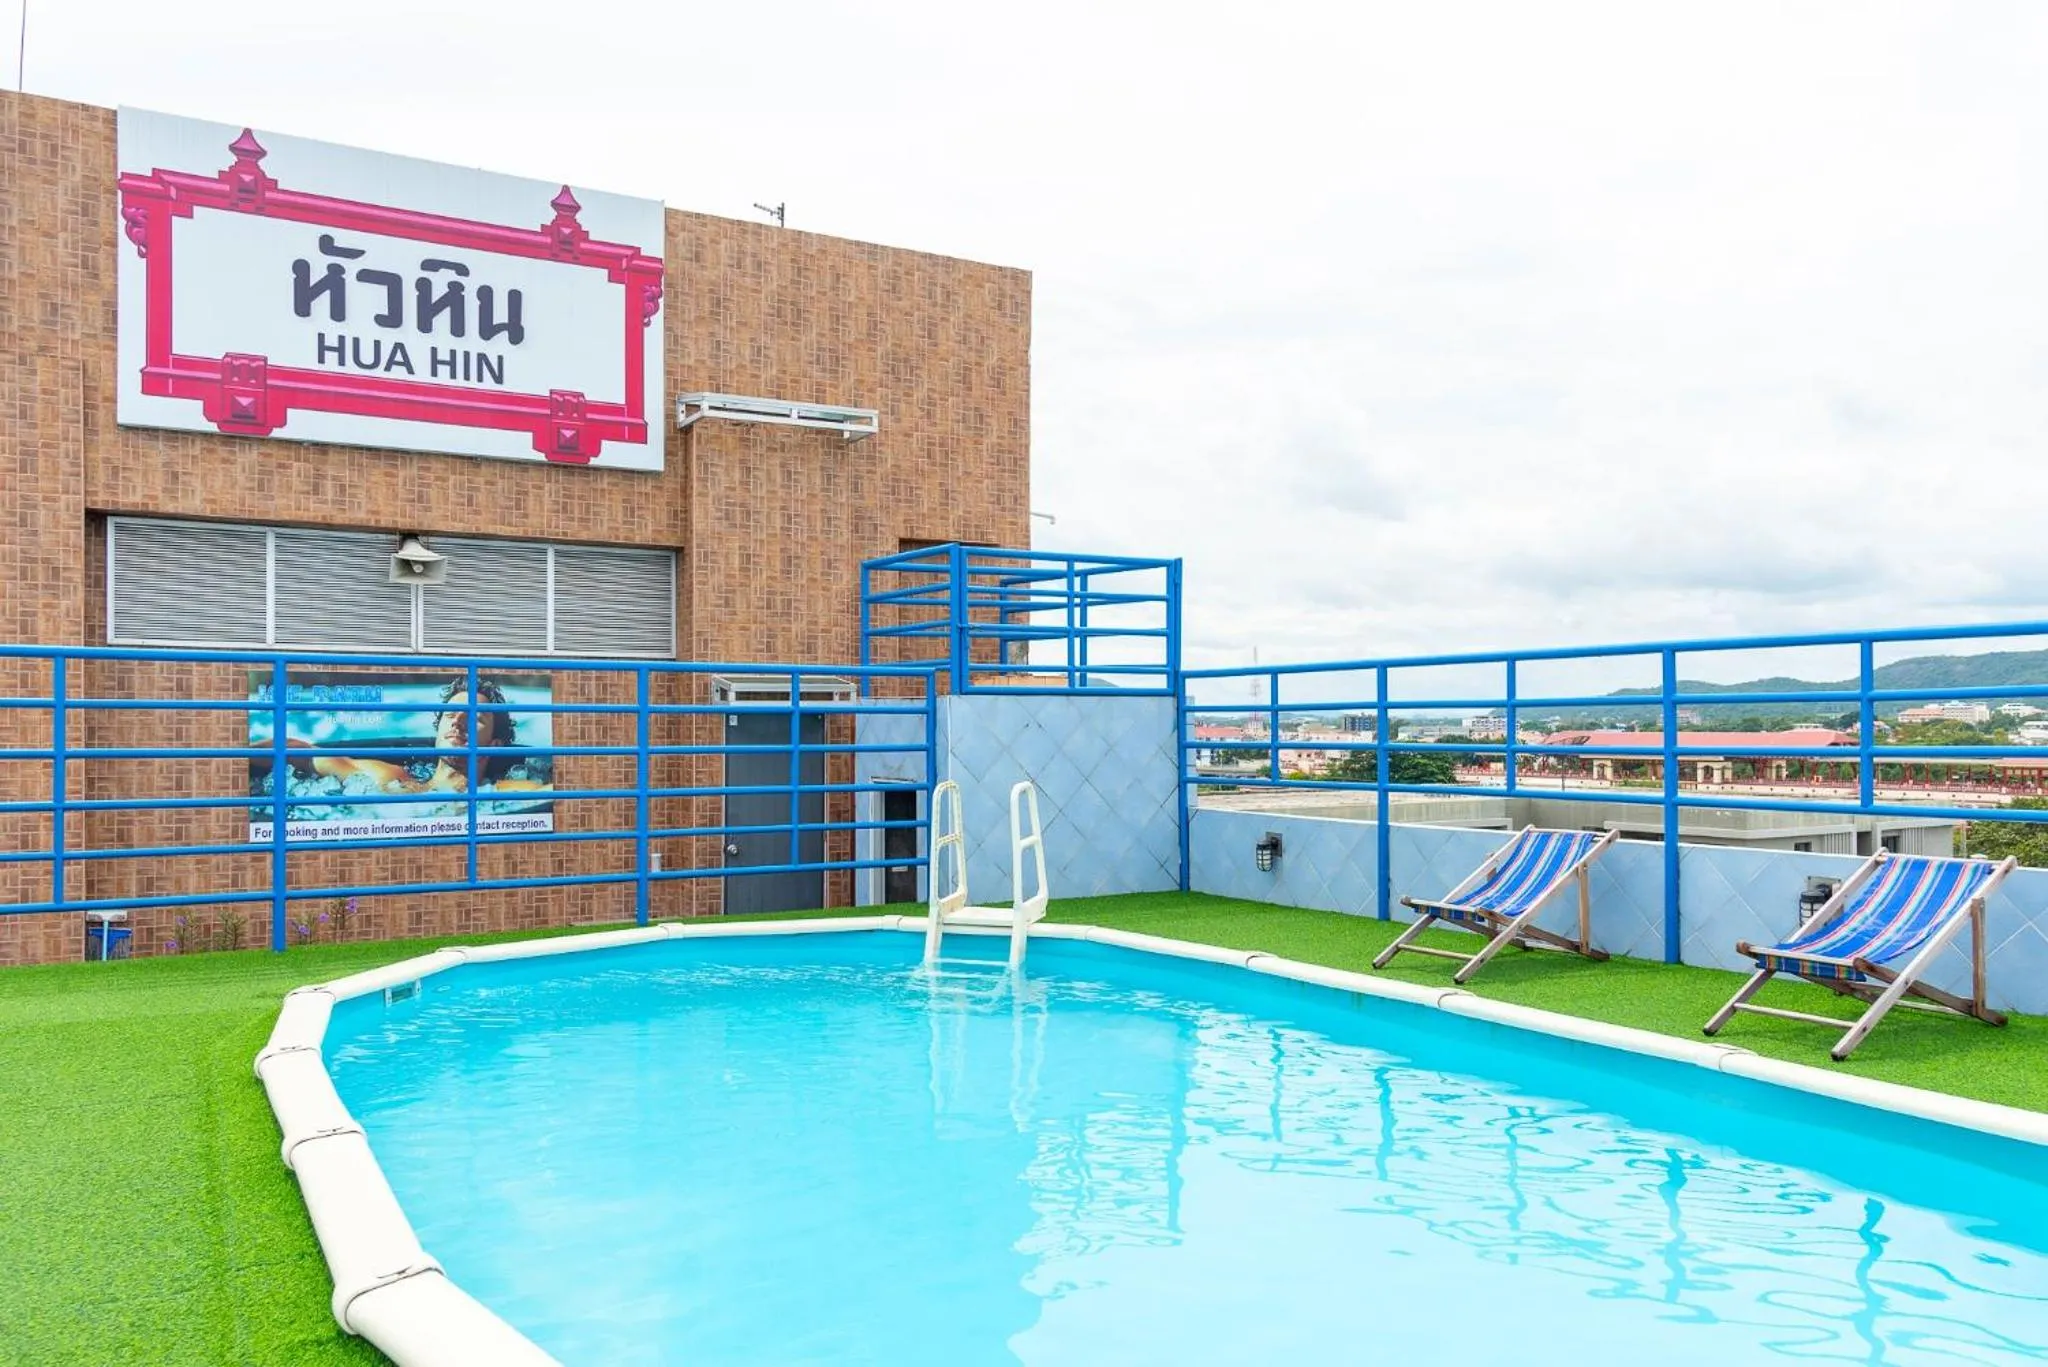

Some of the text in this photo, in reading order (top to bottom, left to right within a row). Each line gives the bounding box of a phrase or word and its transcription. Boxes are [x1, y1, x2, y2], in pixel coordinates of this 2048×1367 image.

[292, 234, 525, 345] หัวหิน
[317, 332, 505, 385] HUA HIN
[254, 818, 548, 839] For ooking and more information please cntact reception.
